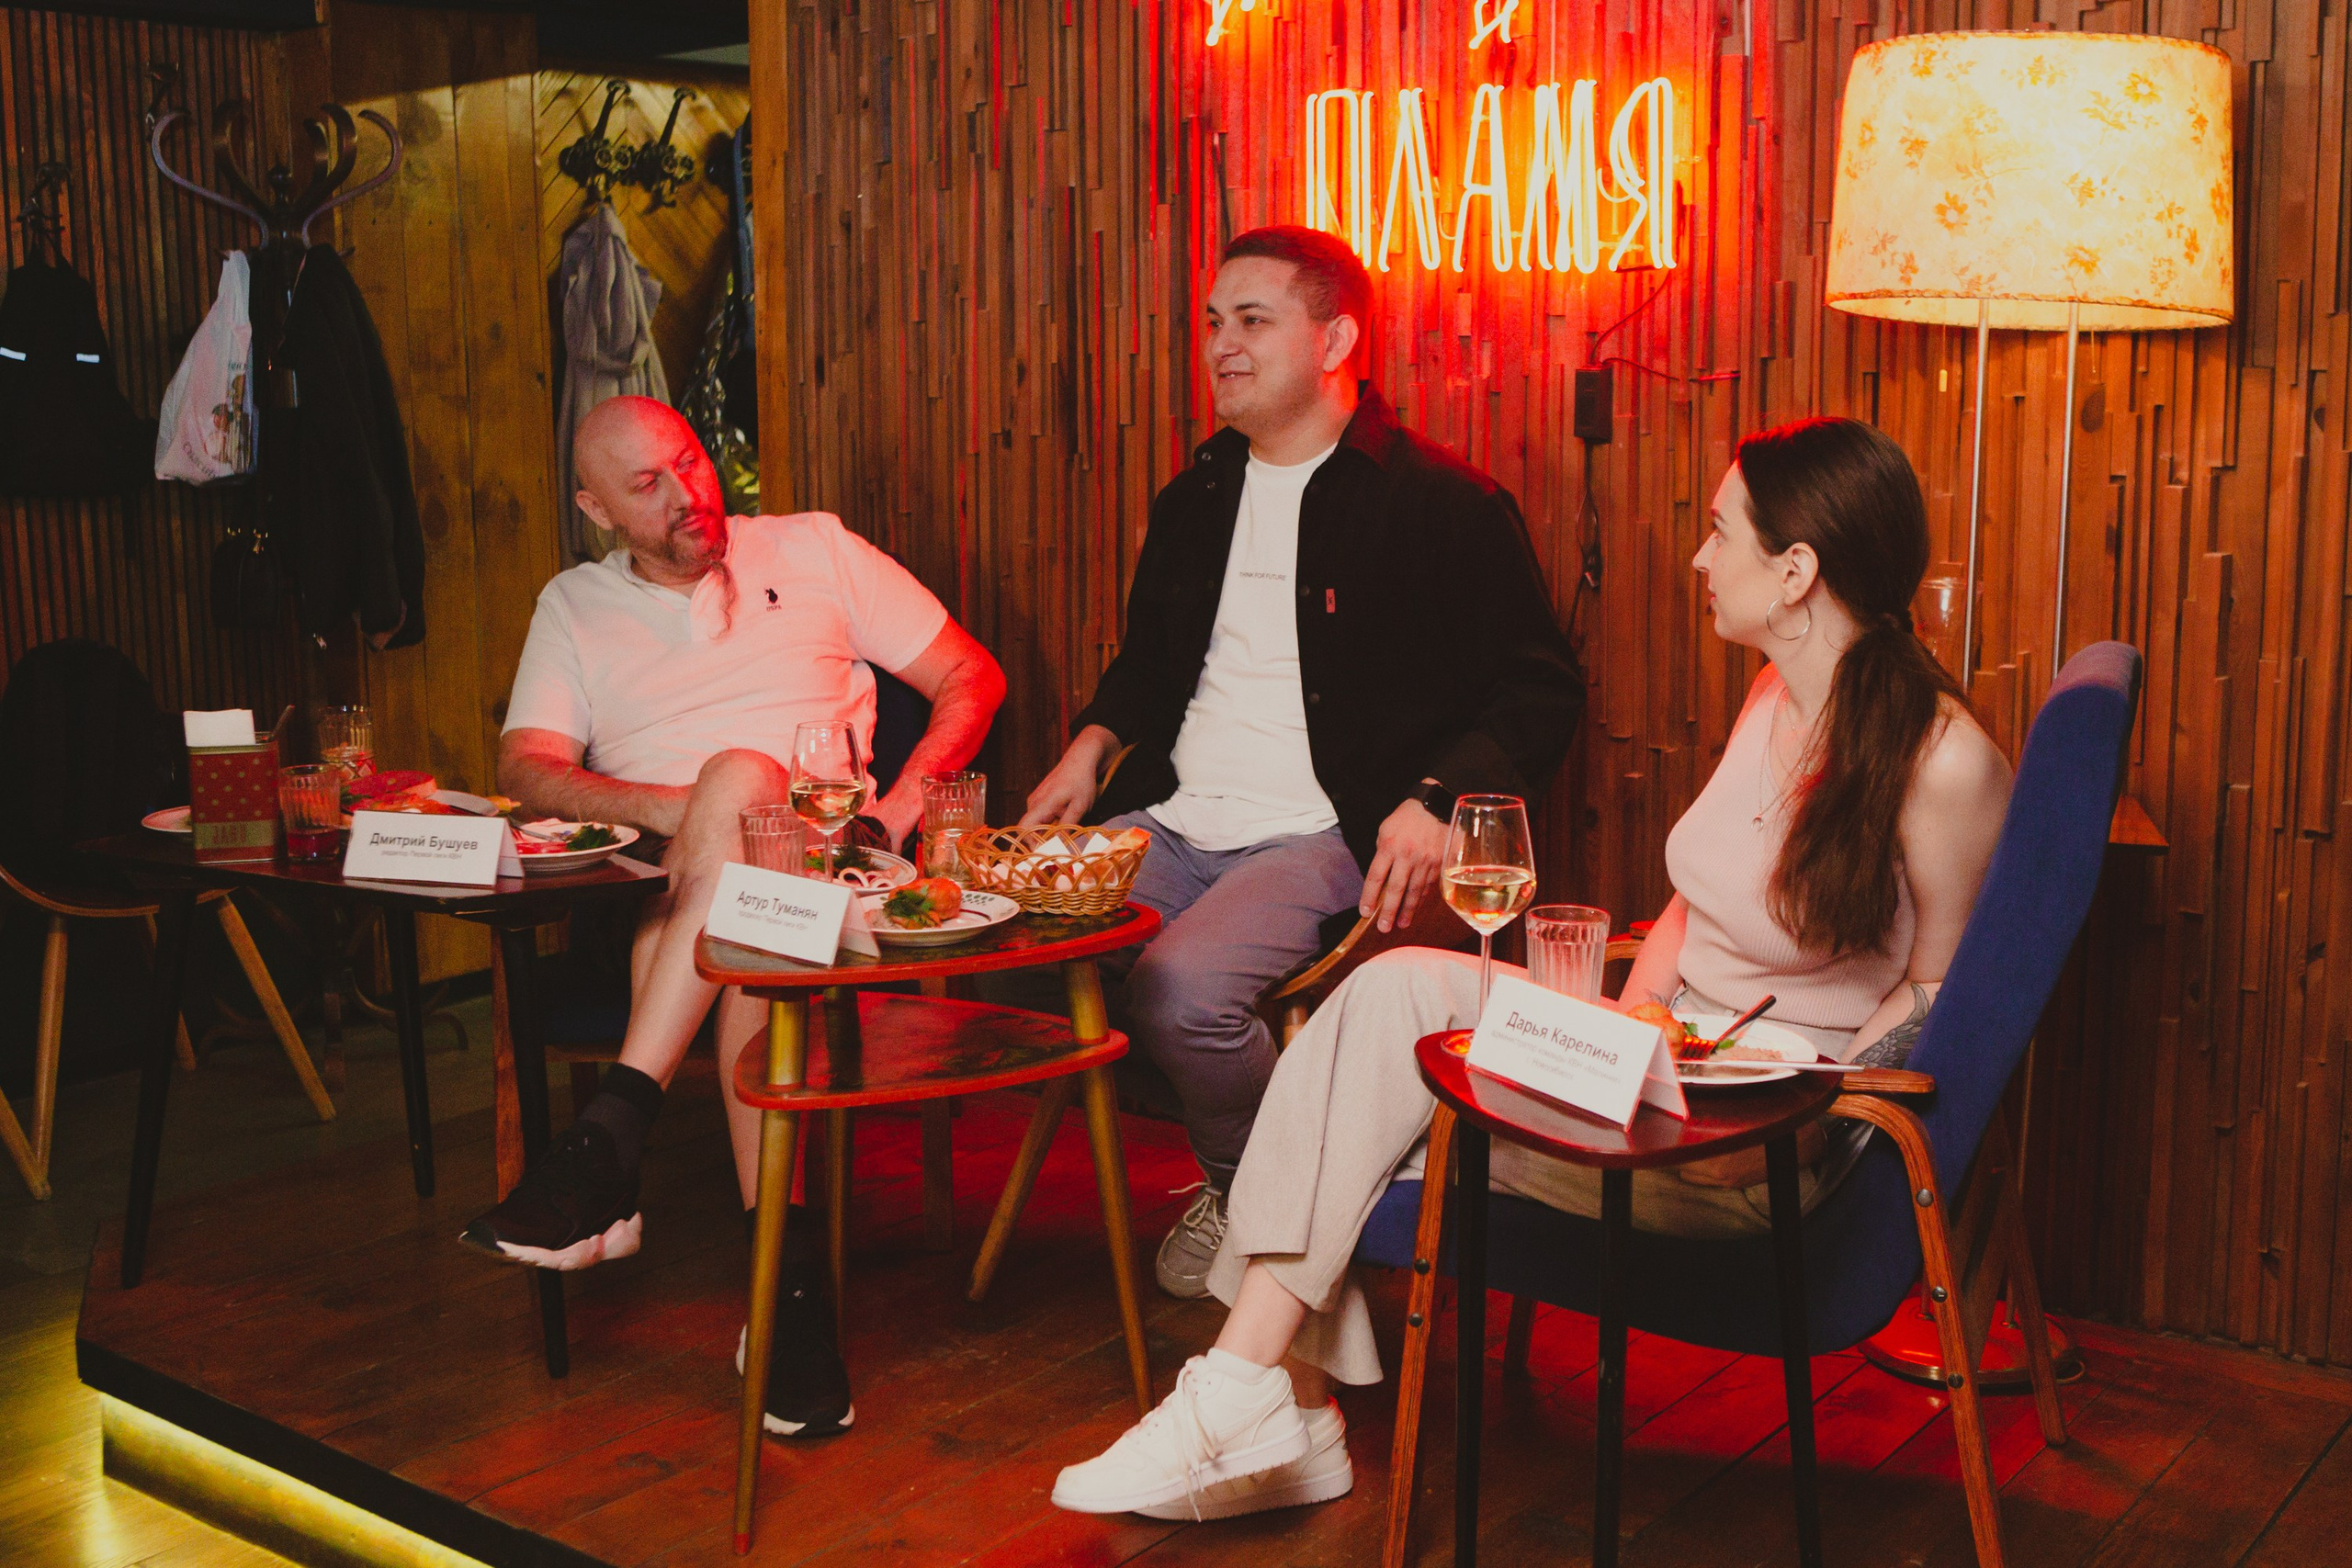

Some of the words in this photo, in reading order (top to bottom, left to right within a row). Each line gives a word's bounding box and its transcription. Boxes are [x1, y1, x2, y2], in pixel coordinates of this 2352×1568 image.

[1305, 76, 1678, 275] ПЛАМЯ
[369, 832, 425, 848] Дмитрий
[429, 836, 479, 852] Бушуев
[737, 890, 769, 911] Артур
[772, 897, 819, 920] Туманян
[1506, 1011, 1548, 1039] Дарья
[1551, 1027, 1619, 1066] Карелина
